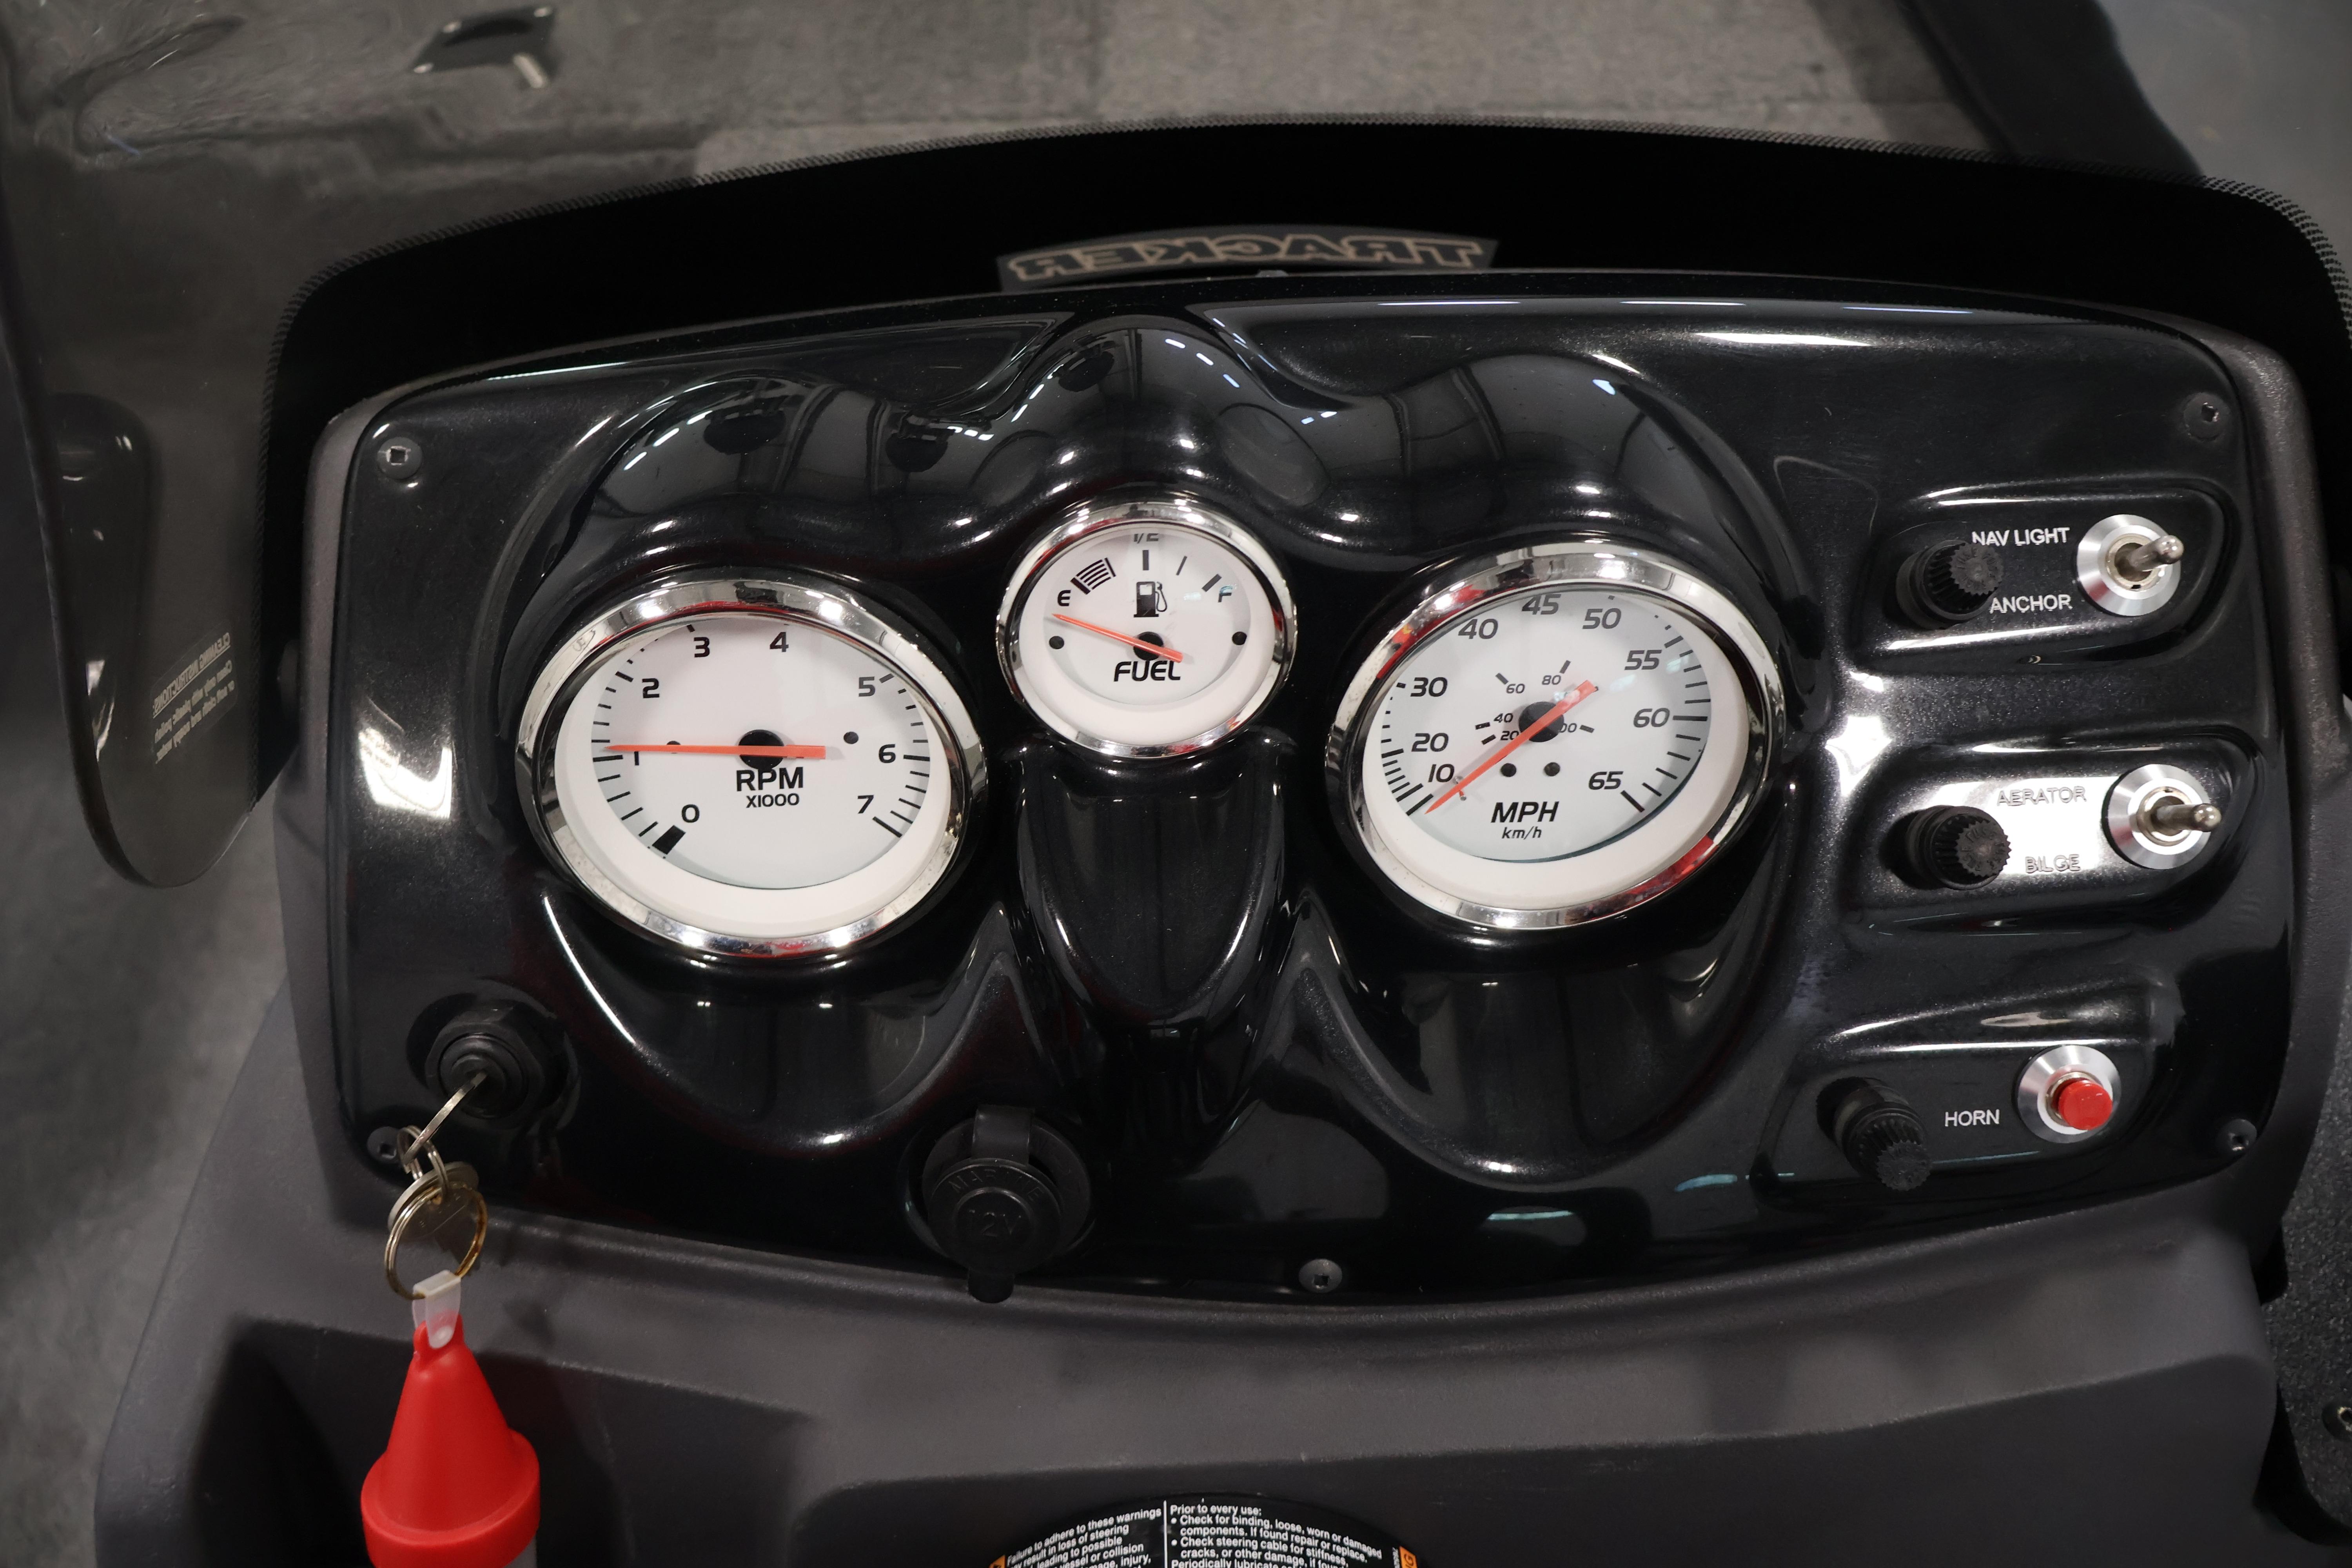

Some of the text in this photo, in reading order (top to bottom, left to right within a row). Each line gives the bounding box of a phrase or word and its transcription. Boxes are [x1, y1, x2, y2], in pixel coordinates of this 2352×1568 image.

[1972, 527, 2070, 547] NAV LIGHT
[1057, 590, 1071, 606] E
[1218, 585, 1233, 603] F
[1522, 593, 1561, 615] 45
[1989, 594, 2073, 614] ANCHOR
[1583, 608, 1622, 629] 50
[1458, 618, 1498, 640] 40
[693, 637, 710, 658] 3
[769, 632, 789, 652] 4
[1624, 649, 1662, 670] 55
[1114, 661, 1181, 682] FUEL
[1542, 675, 1561, 685] 80
[642, 678, 660, 699] 2
[858, 676, 876, 697] 5
[1410, 677, 1448, 697] 30
[1506, 683, 1525, 694] 60
[1493, 713, 1514, 723] 40
[1559, 723, 1577, 733] 00
[1633, 708, 1670, 728] 60
[1411, 733, 1449, 752] 20
[1500, 730, 1519, 741] 20
[878, 744, 896, 764] 6
[736, 767, 804, 792] RPM
[1428, 764, 1455, 783] 10
[1588, 771, 1624, 790] 65
[746, 793, 800, 808] X1000
[857, 795, 874, 814] 7
[1996, 786, 2087, 807] AERATOR
[681, 804, 700, 823] 0
[1491, 801, 1559, 823] MPH
[1502, 826, 1542, 840] km/h
[2025, 854, 2081, 874] BILGE
[1945, 1109, 2000, 1127] HORN
[1171, 1504, 1262, 1516] Prior to every use:
[1007, 1507, 1162, 1567] Failure to adhere to these warnings
[1023, 1548, 1046, 1568] result
[1048, 1546, 1056, 1556] in
[1058, 1539, 1076, 1551] loss
[1078, 1534, 1088, 1545] of
[1090, 1524, 1129, 1538] steering
[1180, 1514, 1213, 1526] Check
[1215, 1515, 1230, 1524] for
[1232, 1515, 1273, 1529] binding,
[1275, 1519, 1305, 1535] loose,
[1306, 1526, 1330, 1540] worn
[1332, 1533, 1341, 1543] or
[1343, 1535, 1382, 1560] damaged
[1250, 1526, 1258, 1537] If
[1259, 1527, 1289, 1541] found
[1290, 1533, 1319, 1547] repair
[1320, 1540, 1331, 1549] or
[1037, 1535, 1123, 1568] leading to possible
[1090, 1552, 1101, 1563] or
[1103, 1544, 1144, 1560] collision
[1121, 1553, 1151, 1567] injury,
[1180, 1535, 1348, 1568] Check steering cable for stiffness,
[1181, 1547, 1219, 1559] cracks,
[1221, 1549, 1233, 1557] or
[1235, 1548, 1262, 1560] other
[1264, 1550, 1308, 1568] damage,
[1309, 1557, 1316, 1568] if
[1171, 1558, 1232, 1568] Periodically
